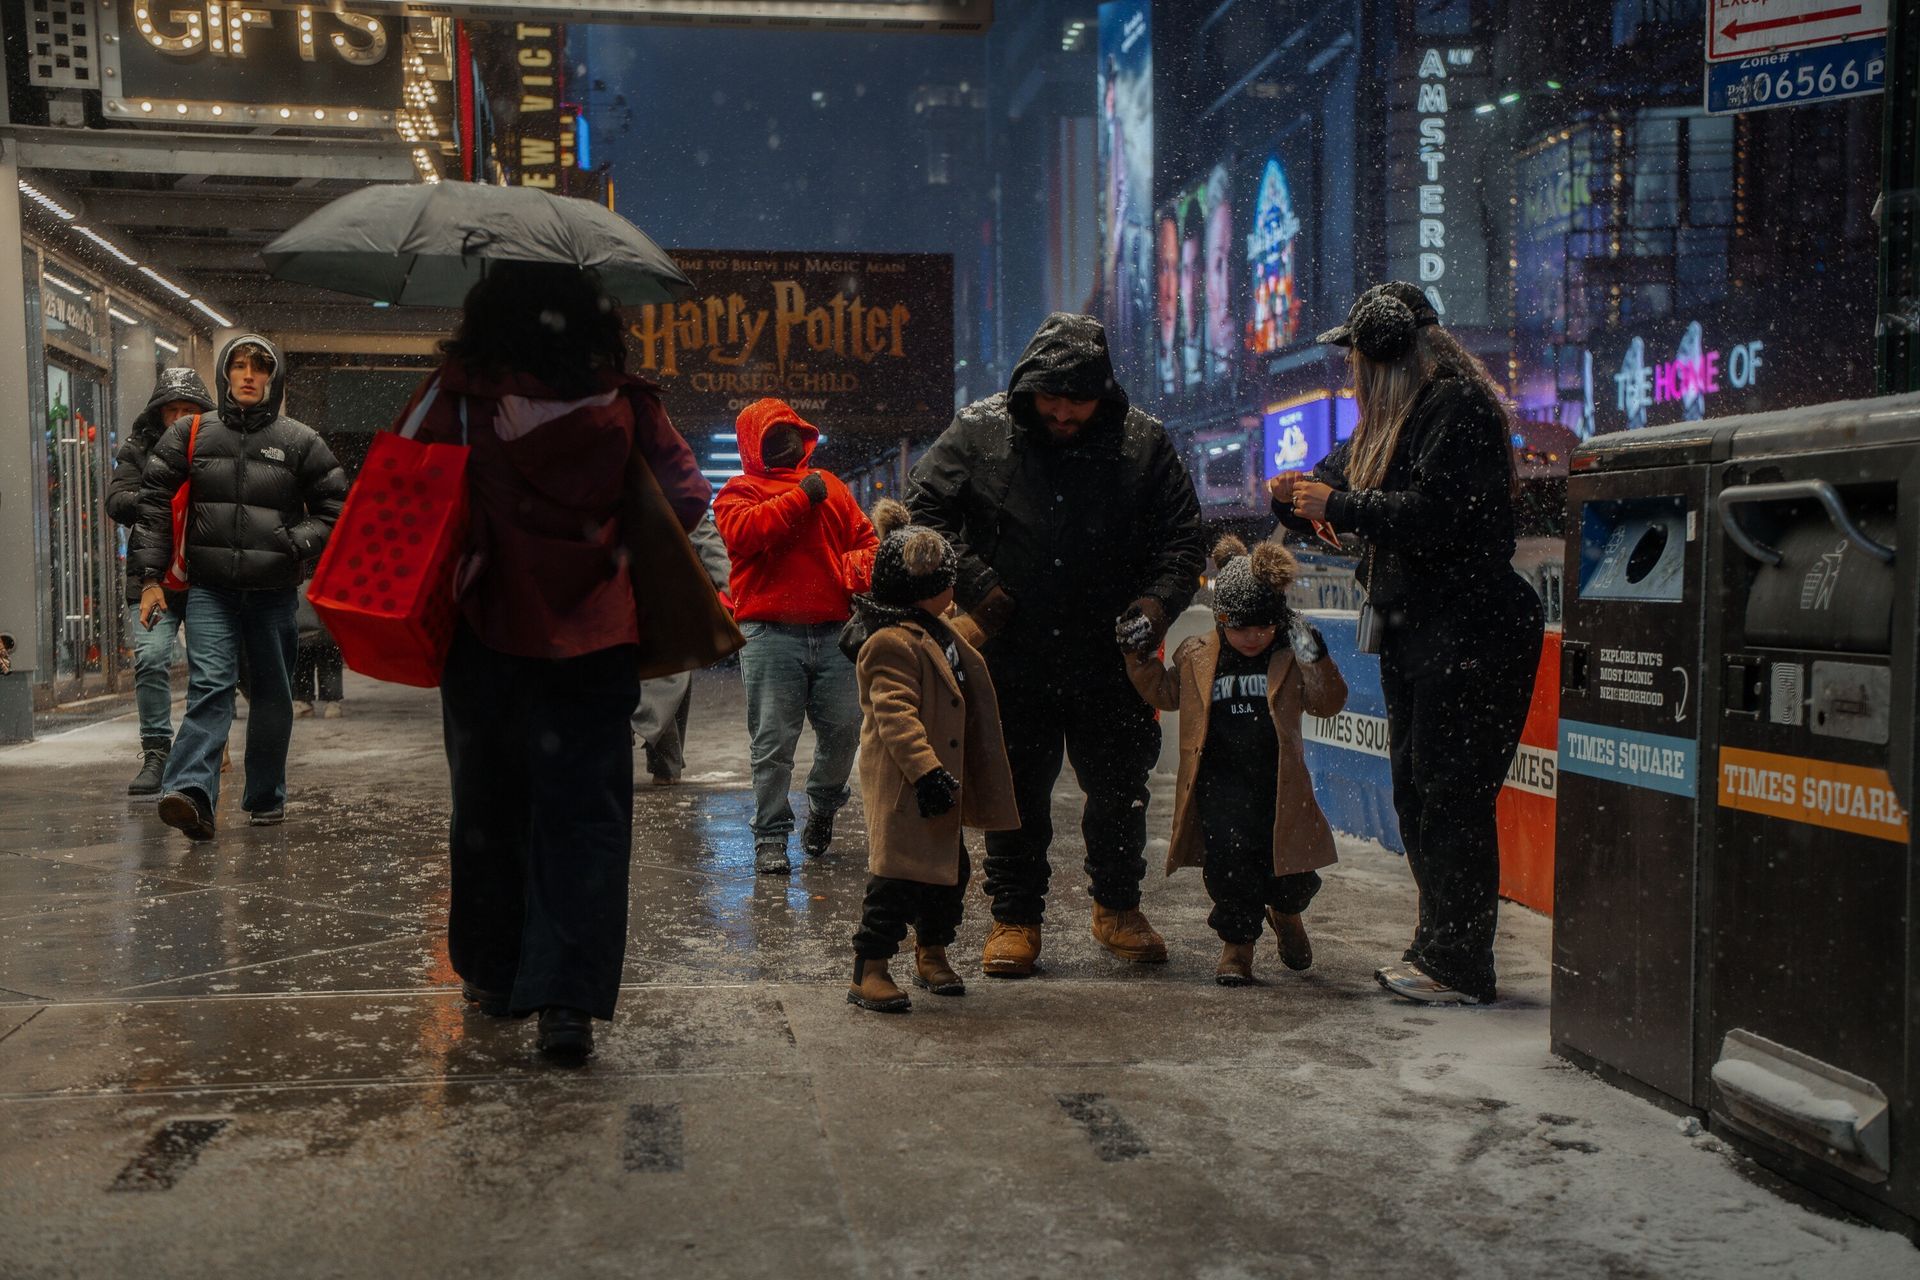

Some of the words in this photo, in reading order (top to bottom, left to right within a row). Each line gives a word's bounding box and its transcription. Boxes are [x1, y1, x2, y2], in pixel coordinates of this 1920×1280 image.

[133, 0, 388, 66] GIFTS
[516, 22, 554, 112] VICT
[1740, 53, 1789, 69] Zone#
[804, 258, 860, 273] MAGIC
[865, 262, 906, 273] AGAIN
[630, 292, 769, 376] Harry
[770, 281, 911, 381] Potter
[1729, 339, 1765, 389] OF
[691, 373, 778, 392] CURSED
[787, 373, 860, 392] CHILD
[1600, 648, 1636, 665] EXPLORE
[1637, 651, 1663, 667] NYC'S
[1600, 667, 1624, 682] MOST
[1624, 670, 1654, 686] ICONIC
[1231, 703, 1254, 715] U.S.A.
[1600, 686, 1664, 707] NEIGHBORHOOD
[1506, 751, 1554, 790] MES
[1567, 732, 1615, 766] TIMES
[1619, 741, 1685, 779] SQUARE
[1724, 763, 1797, 805] TIMES
[1802, 776, 1903, 826] SQUARE
